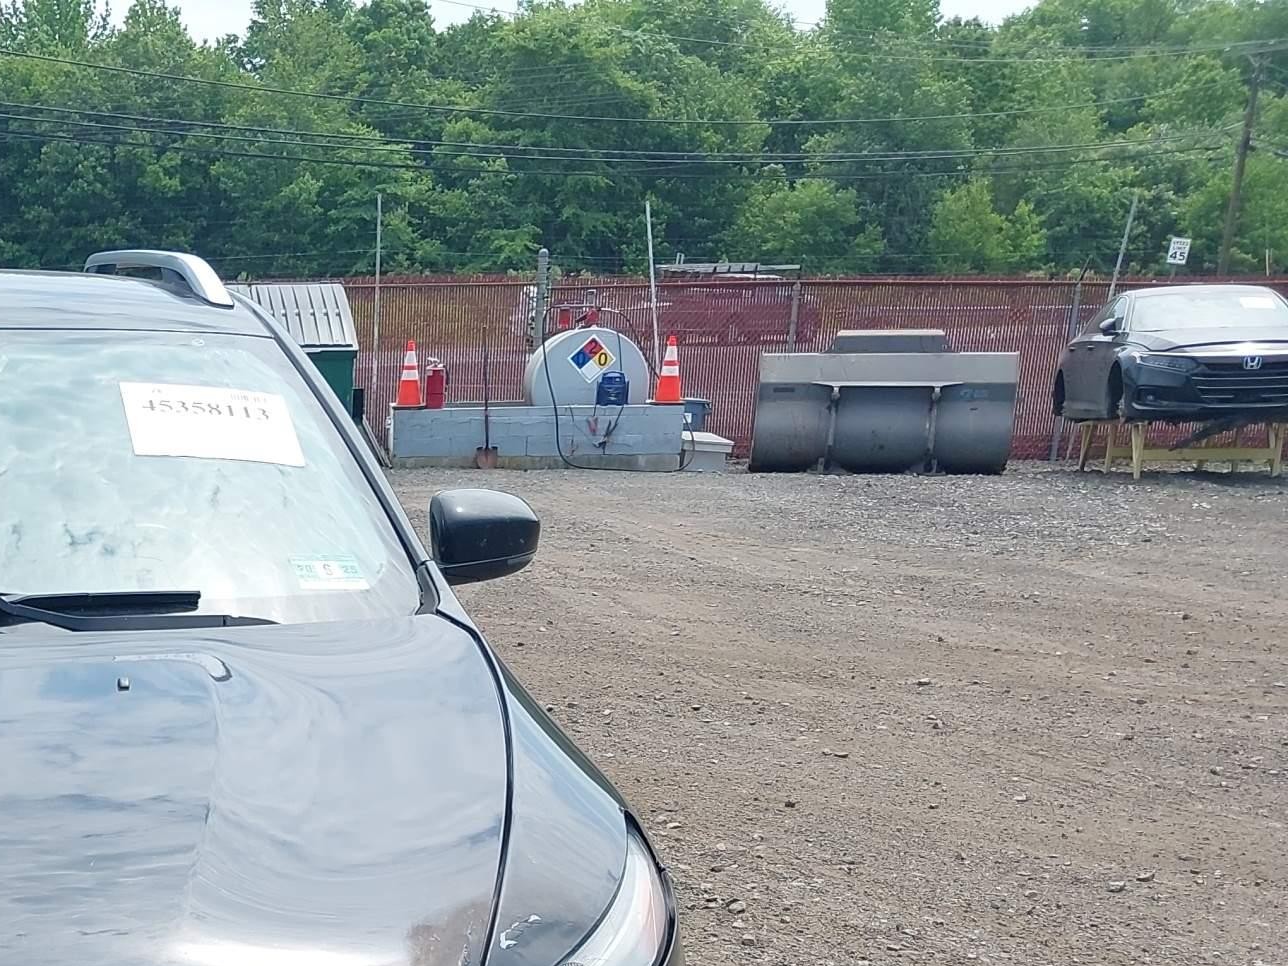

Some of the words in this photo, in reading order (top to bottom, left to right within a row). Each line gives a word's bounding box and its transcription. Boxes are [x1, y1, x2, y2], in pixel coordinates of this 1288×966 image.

[1169, 251, 1186, 261] 45
[589, 340, 598, 354] 2
[598, 352, 608, 366] 0
[142, 399, 270, 421] 45358113
